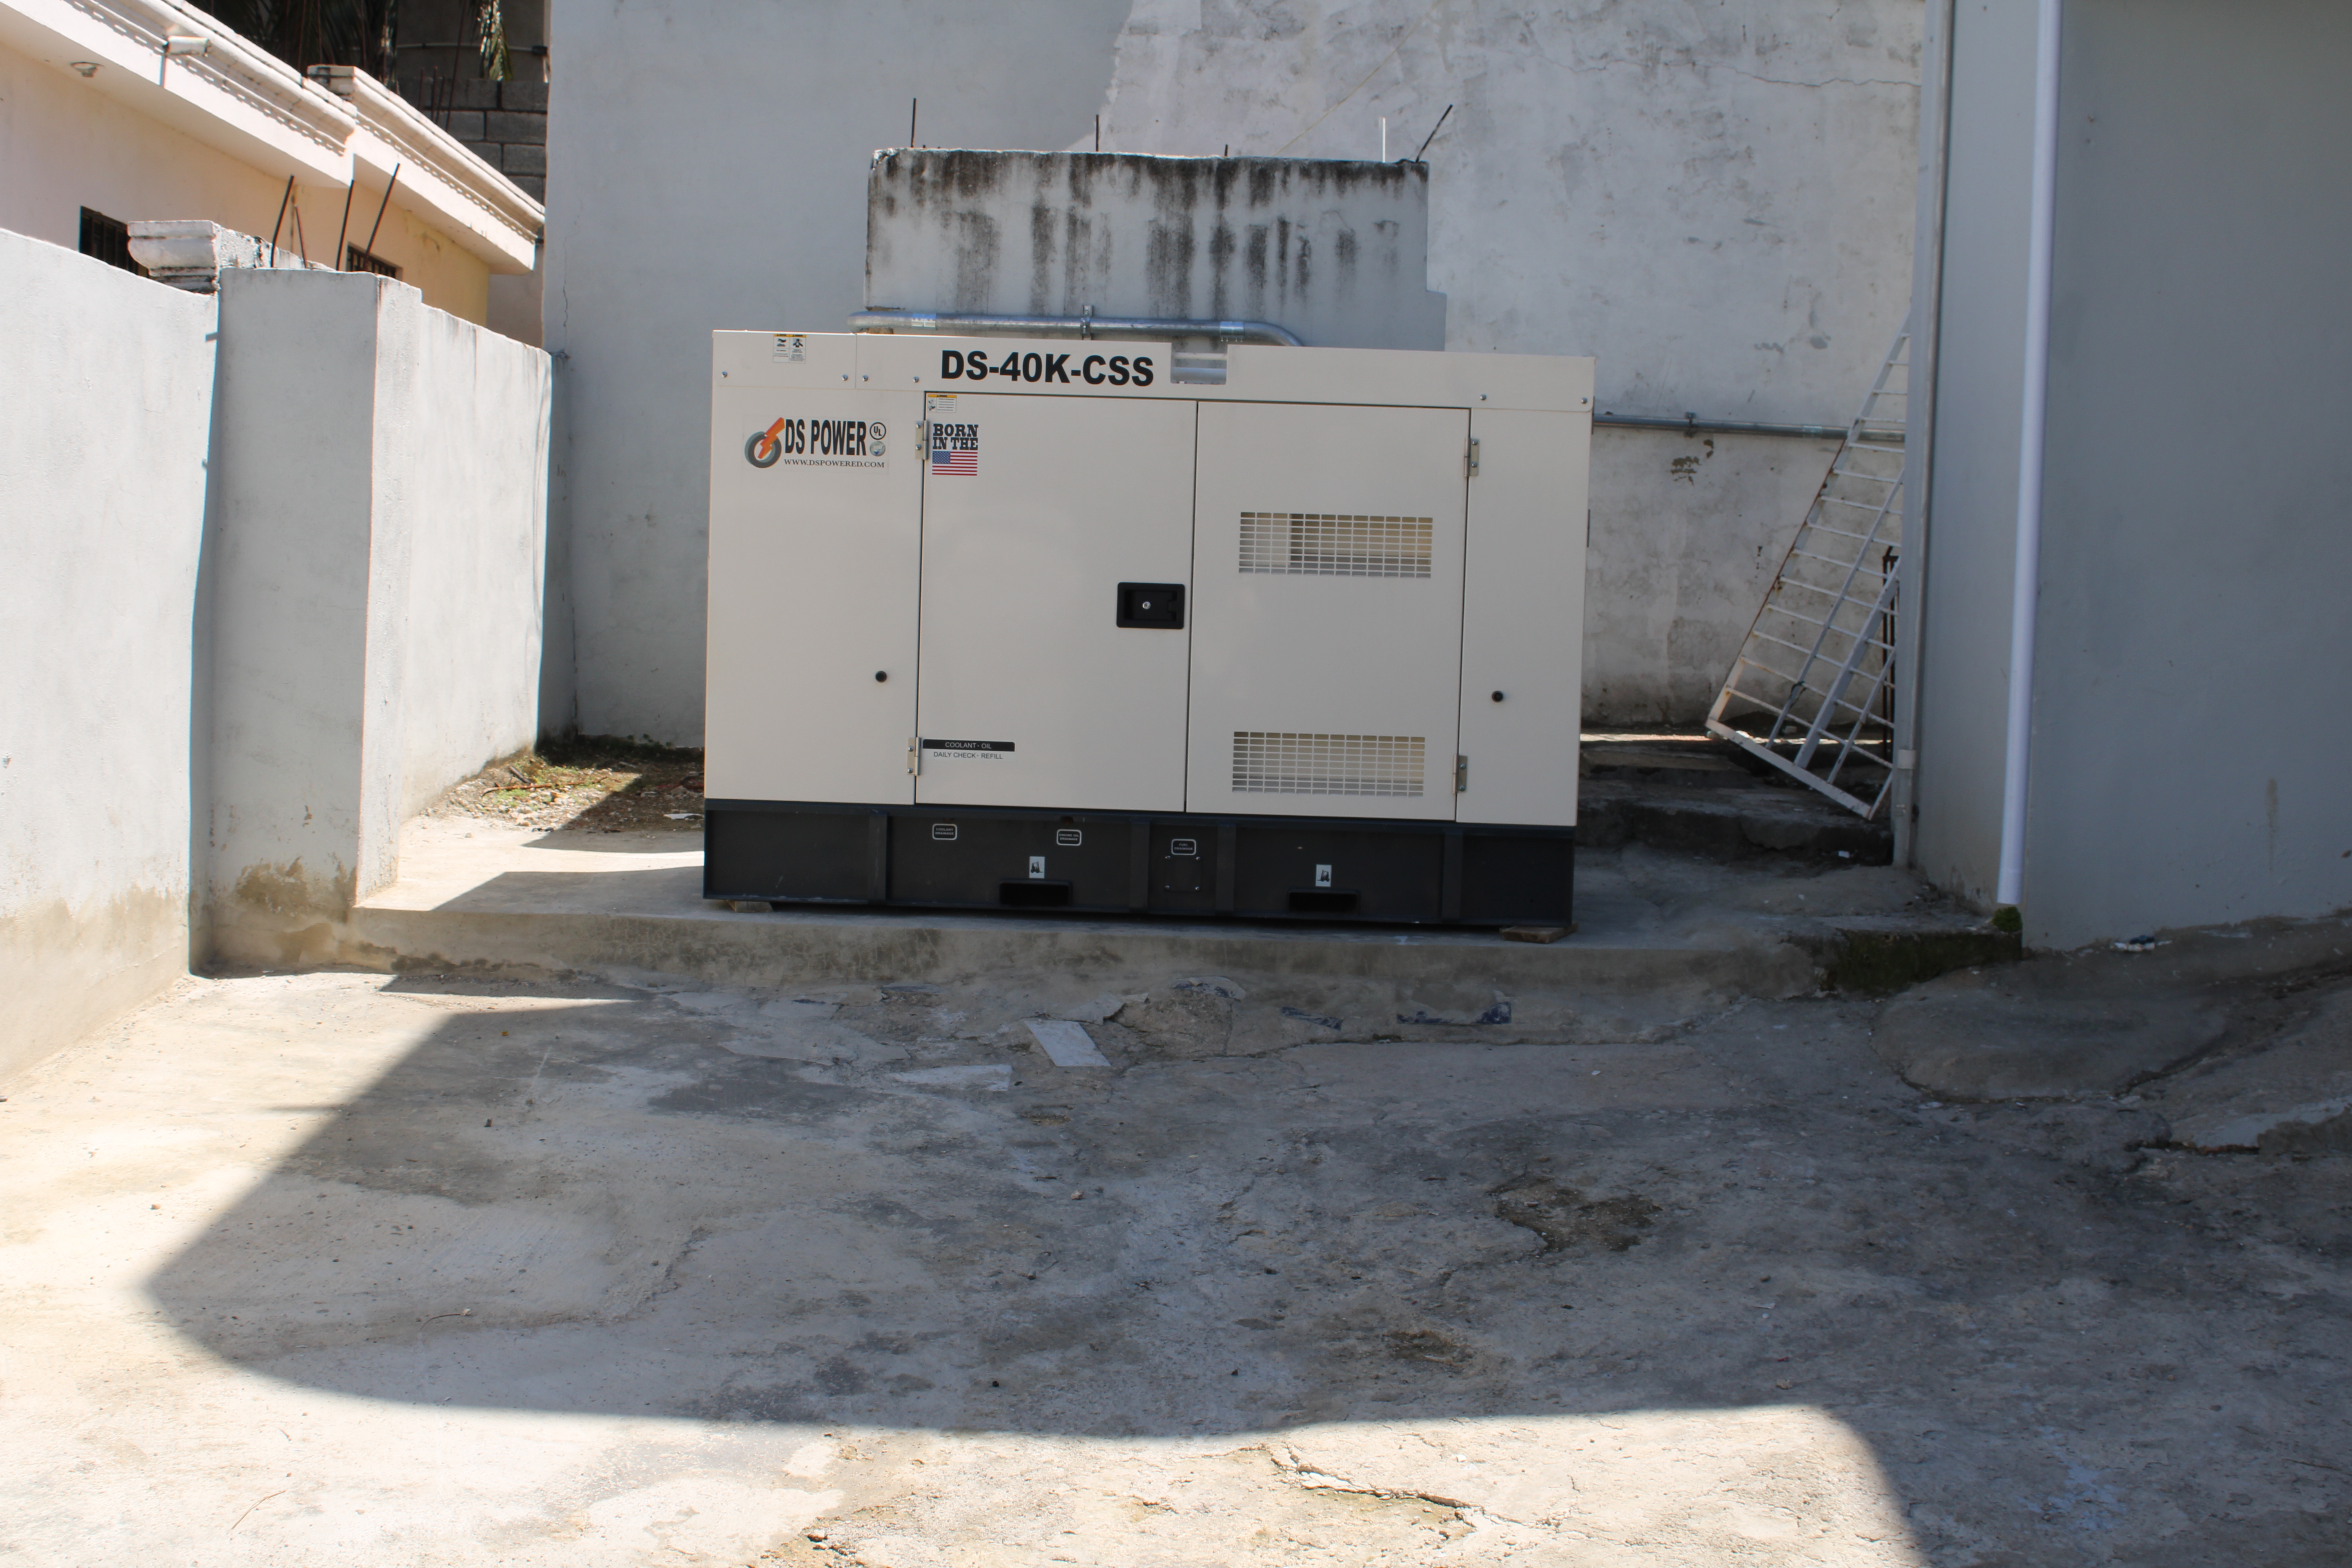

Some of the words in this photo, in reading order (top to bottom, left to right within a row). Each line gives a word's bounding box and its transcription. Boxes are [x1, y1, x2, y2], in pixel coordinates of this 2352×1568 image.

[941, 350, 1154, 387] DS-40K-CSS
[785, 418, 806, 455] DS
[810, 419, 867, 456] POWER
[873, 426, 882, 436] UL
[933, 423, 979, 437] BORN
[933, 436, 948, 450] IN
[951, 437, 978, 450] THE
[784, 459, 885, 468] WWW.DSPOWERED.COM
